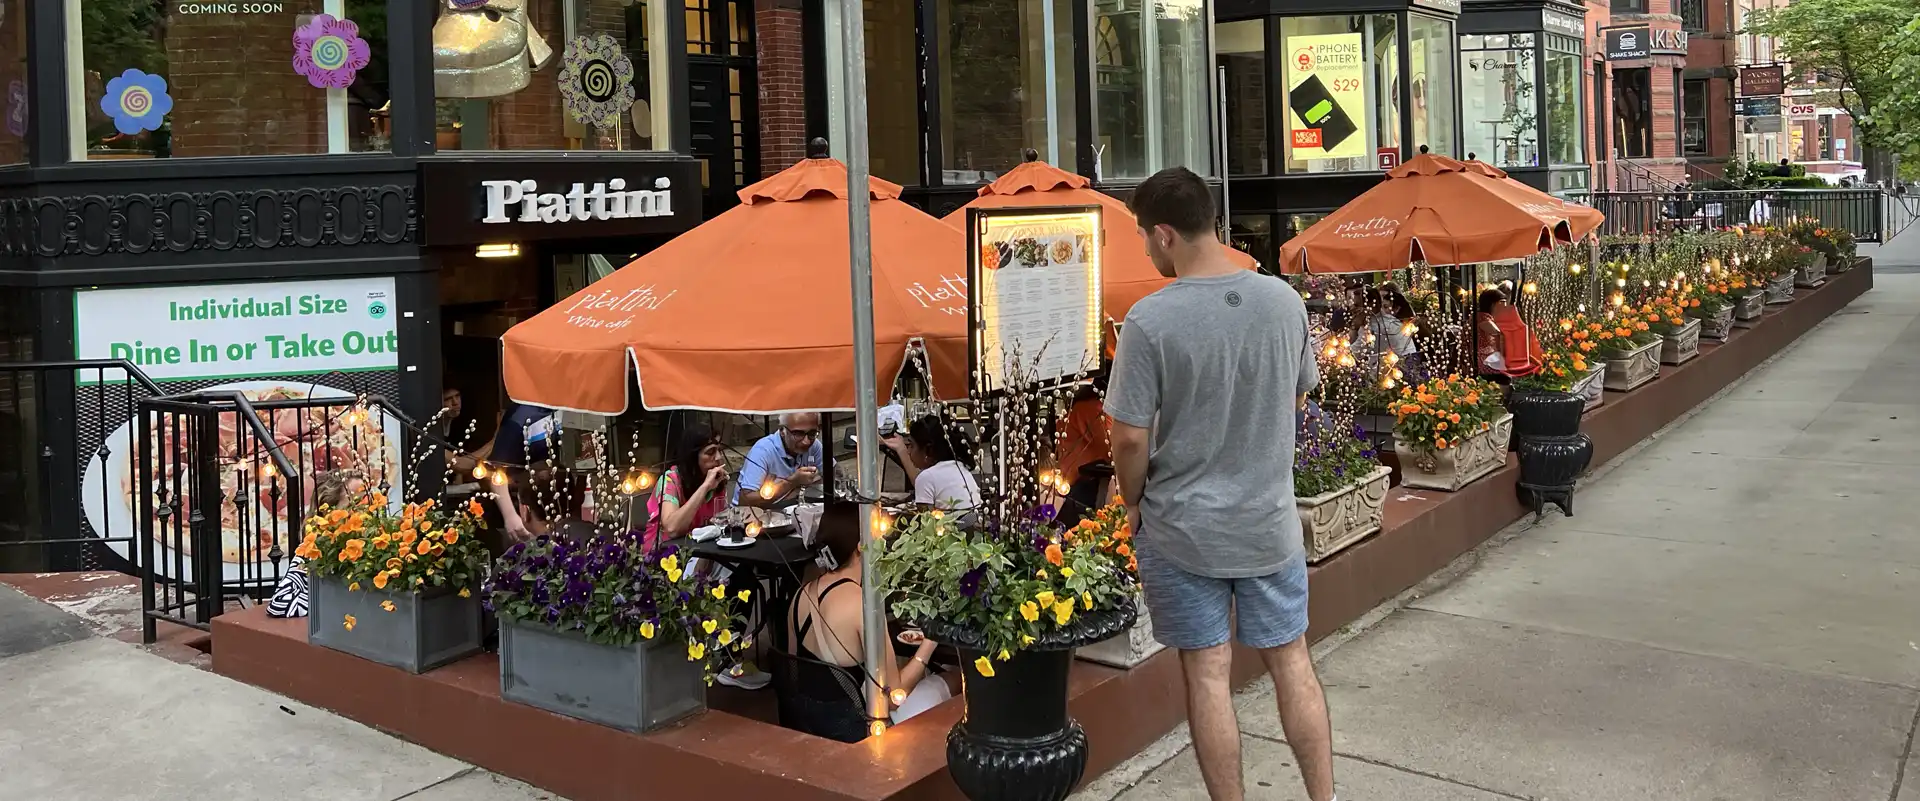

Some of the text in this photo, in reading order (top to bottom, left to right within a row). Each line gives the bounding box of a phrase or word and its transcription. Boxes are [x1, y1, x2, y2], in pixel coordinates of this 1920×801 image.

[179, 3, 283, 14] COMING SOON
[1316, 43, 1358, 53] iPHONE
[1316, 54, 1357, 64] BATTERY
[1333, 78, 1360, 92] $29
[1791, 105, 1815, 114] CVS
[482, 177, 674, 223] Piattini
[1333, 216, 1409, 234] piattin
[564, 284, 677, 314] piattini
[170, 294, 348, 321] Individual Size
[567, 315, 604, 328] wine
[110, 330, 398, 365] Dine In or Take Out
